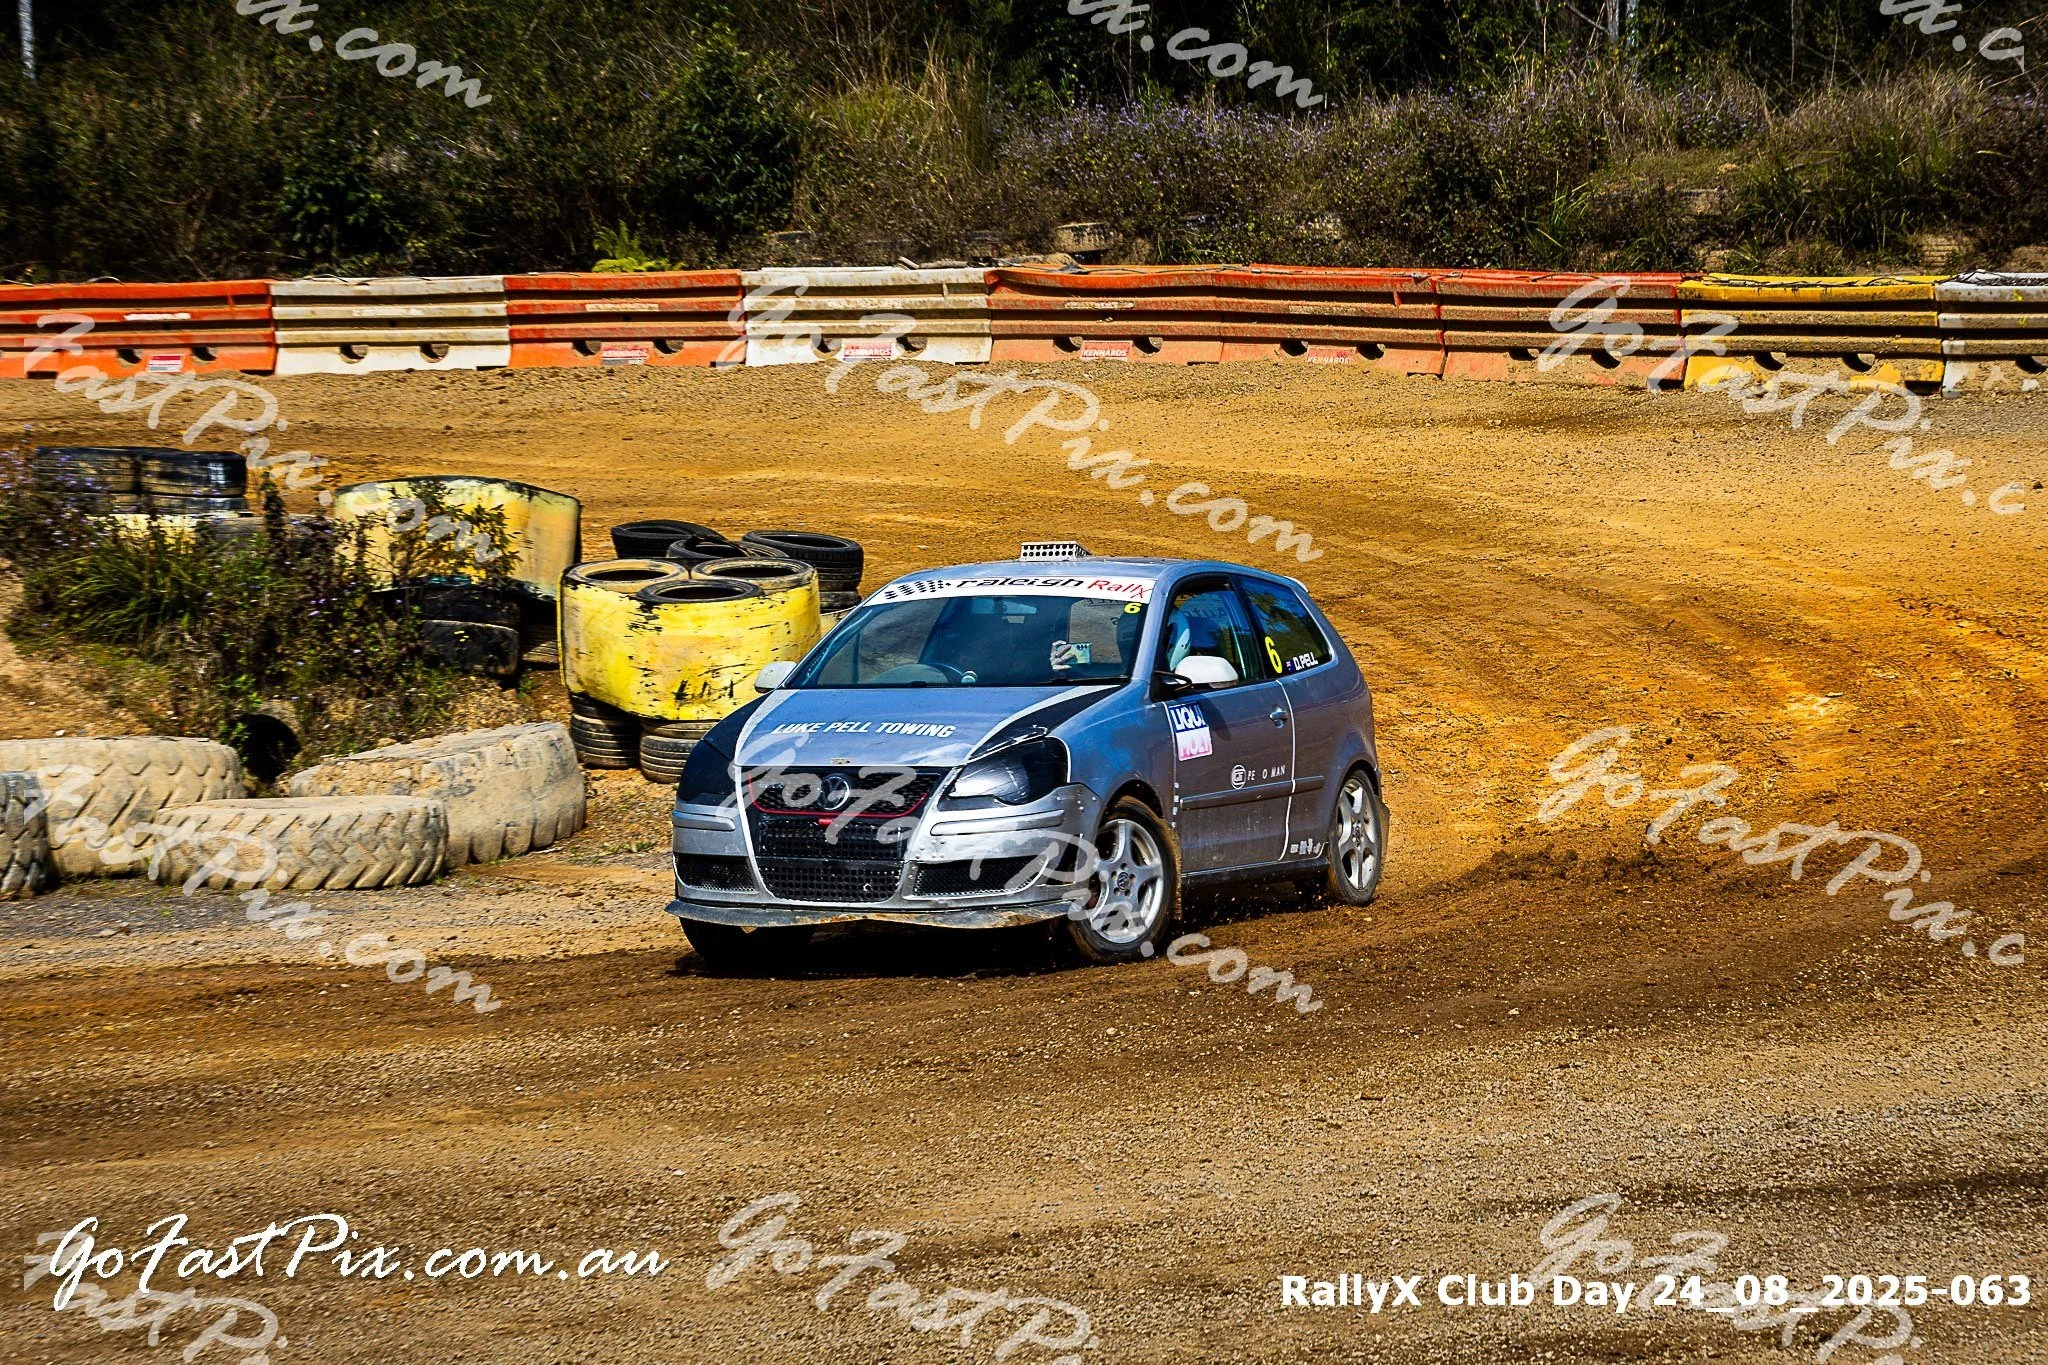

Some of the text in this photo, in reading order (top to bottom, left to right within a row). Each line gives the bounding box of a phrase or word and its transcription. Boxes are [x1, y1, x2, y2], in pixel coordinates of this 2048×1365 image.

[1082, 349, 1128, 357] KENNARDS
[956, 577, 1084, 588] raleigh
[1124, 602, 1142, 614] 6
[1264, 636, 1283, 673] 6
[1292, 651, 1319, 671] D.PELL
[771, 721, 957, 738] LUKE PELL TOWING
